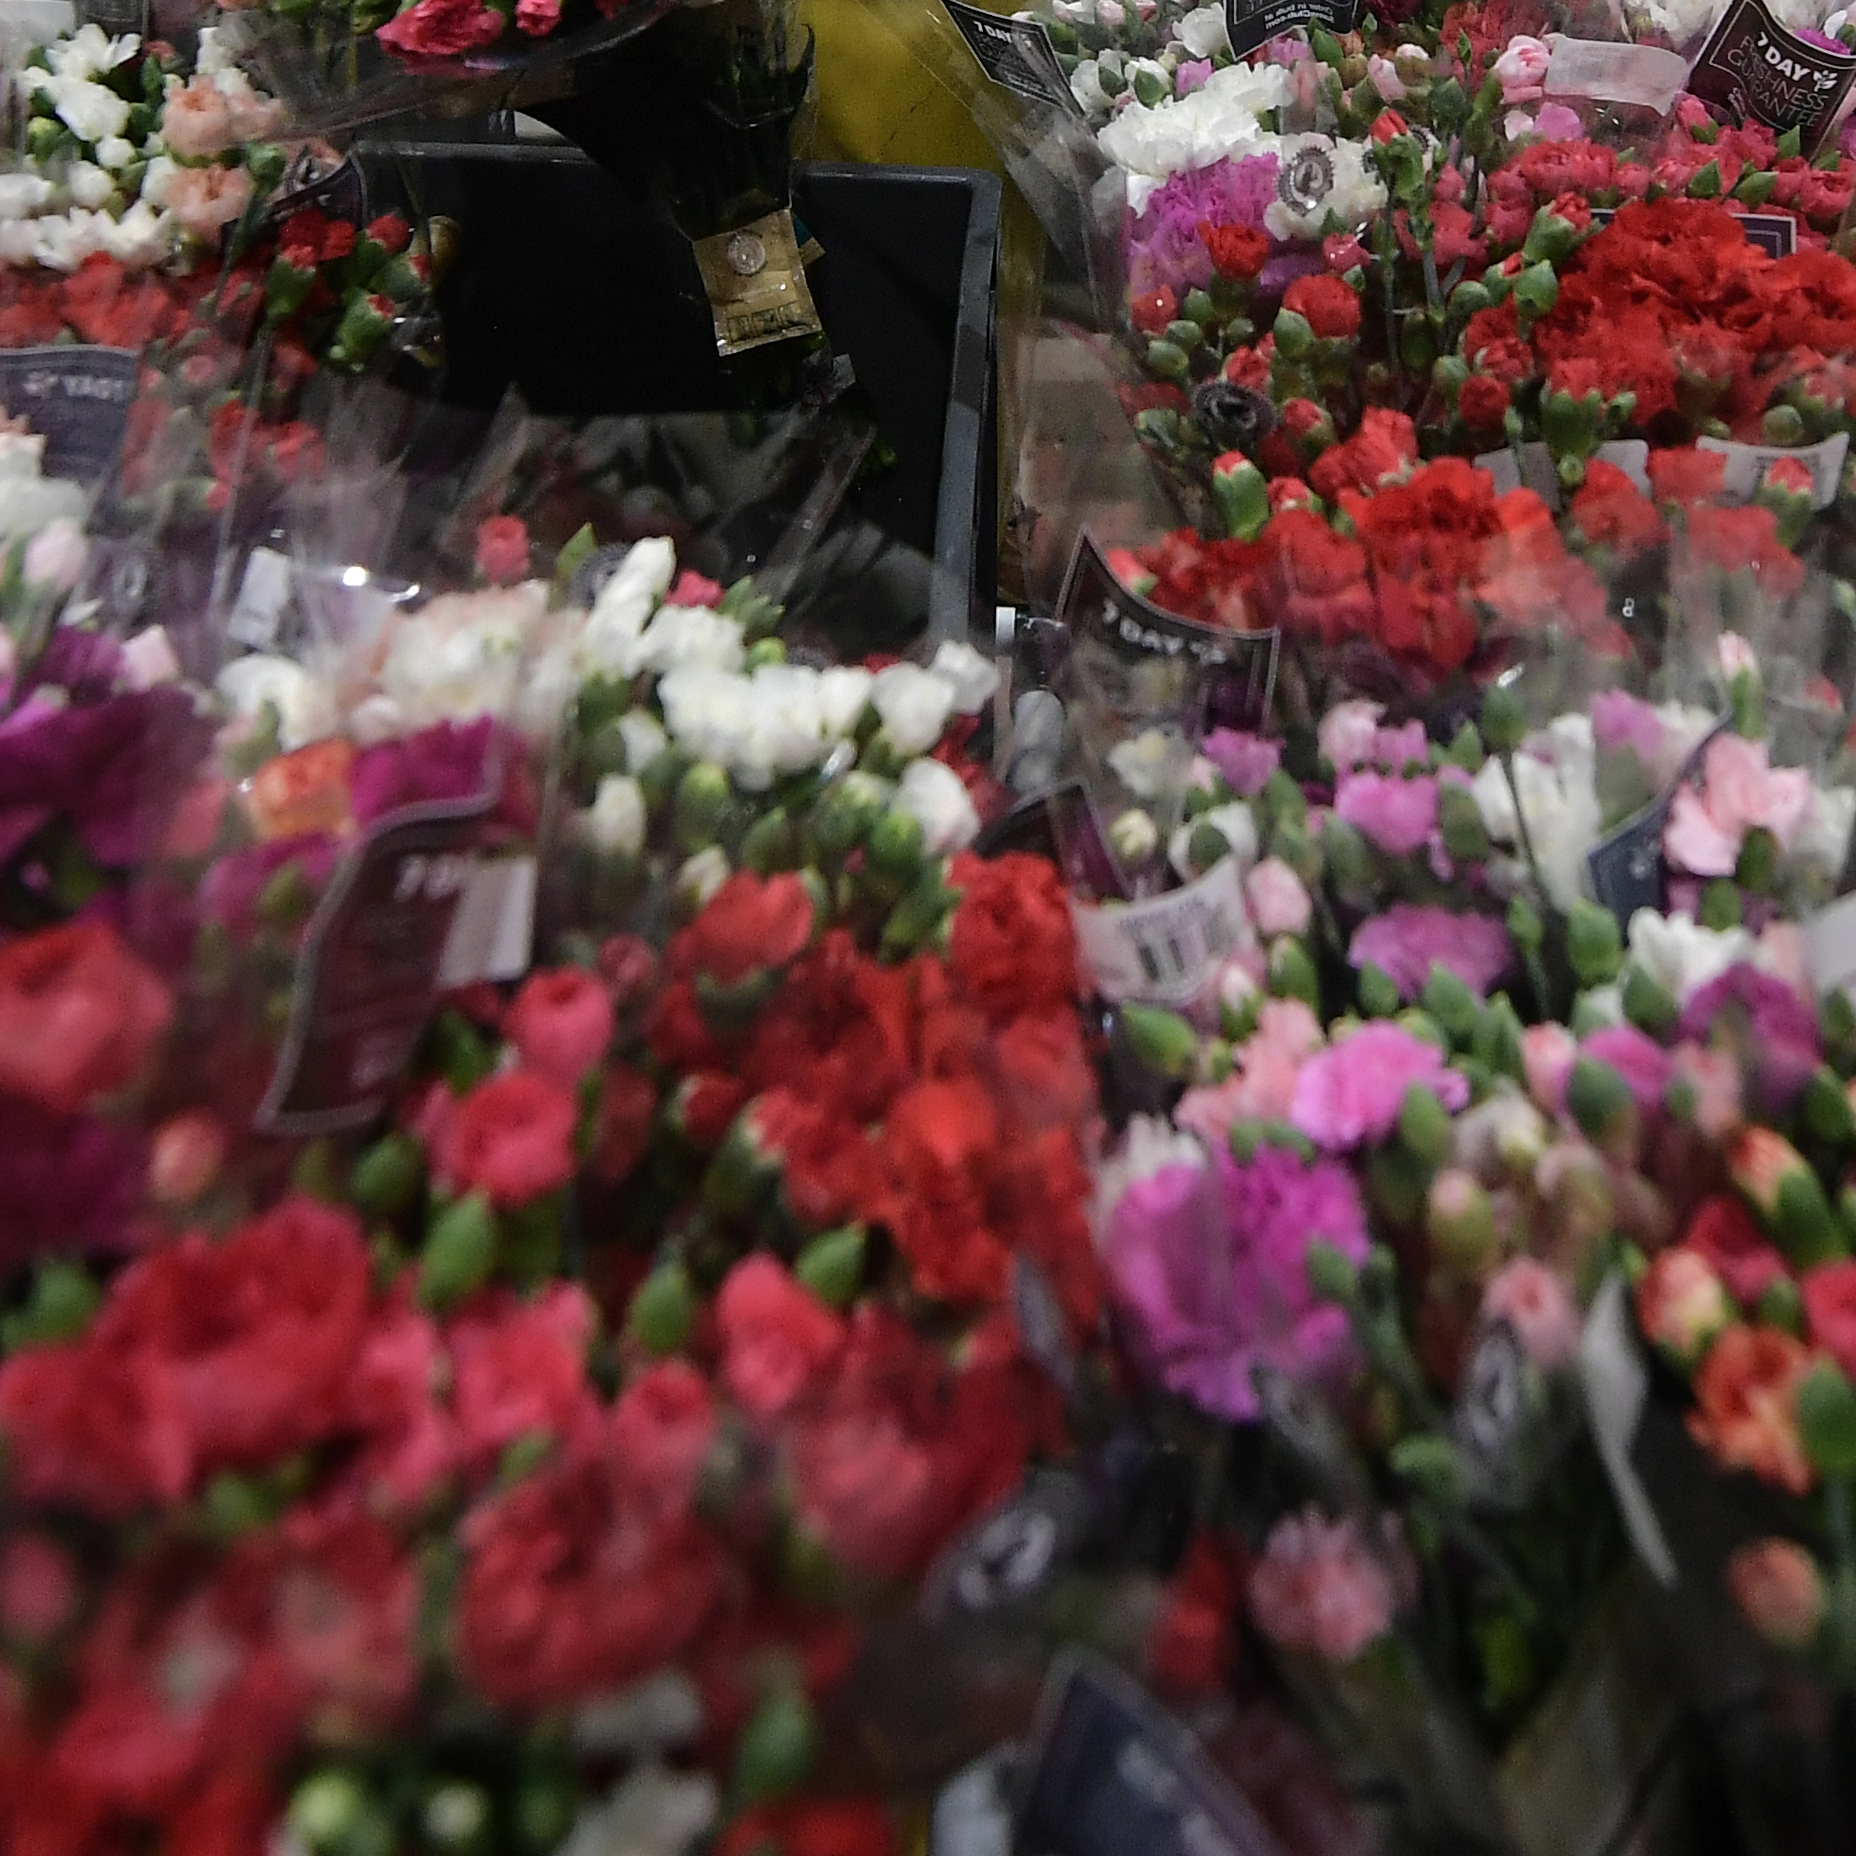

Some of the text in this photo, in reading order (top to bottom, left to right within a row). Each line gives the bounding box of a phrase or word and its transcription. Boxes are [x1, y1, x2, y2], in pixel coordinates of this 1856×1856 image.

[973, 20, 1012, 43] 7 DAY
[1757, 31, 1811, 82] 7 DAY
[1727, 48, 1823, 127] GUARANTEE
[1740, 35, 1829, 111] FRESHNESS
